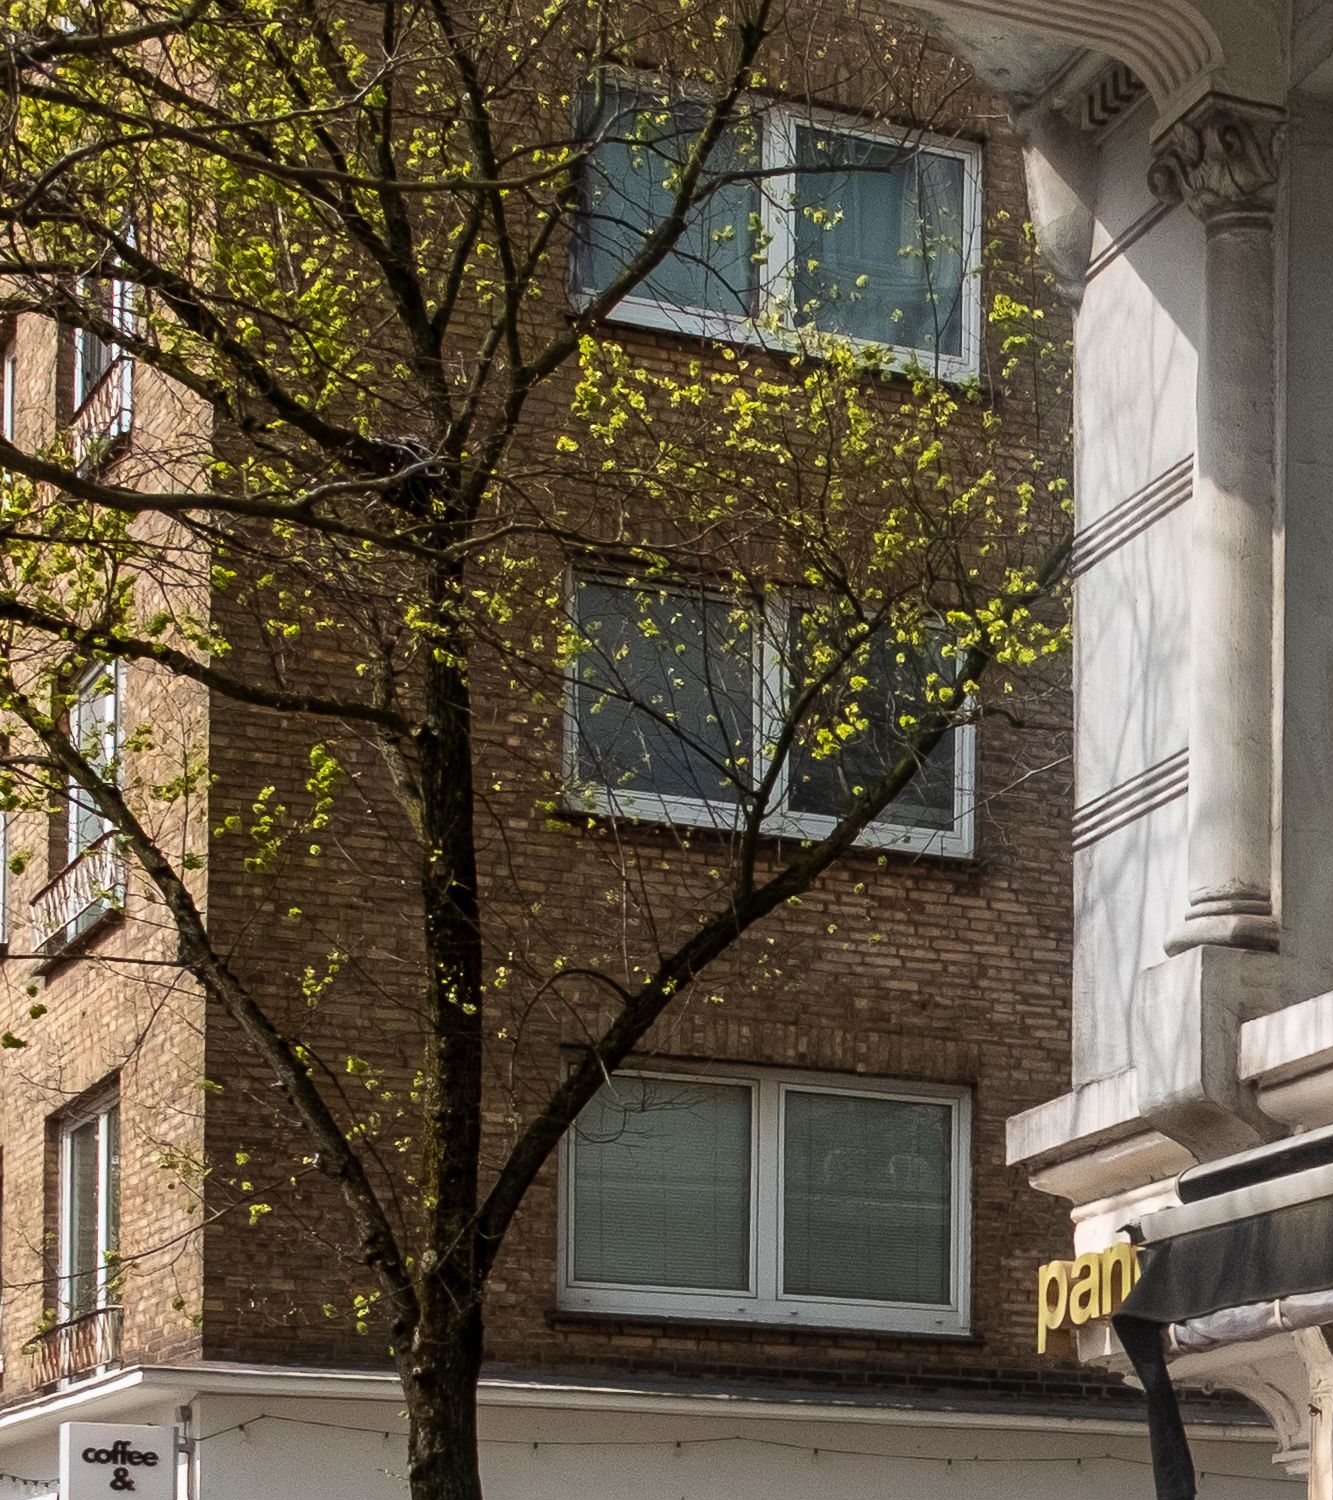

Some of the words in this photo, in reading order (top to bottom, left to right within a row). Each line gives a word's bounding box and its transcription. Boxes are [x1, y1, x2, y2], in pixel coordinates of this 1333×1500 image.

[1038, 1242, 1142, 1354] pan
[82, 1440, 159, 1466] coffee
[110, 1467, 136, 1491] &
